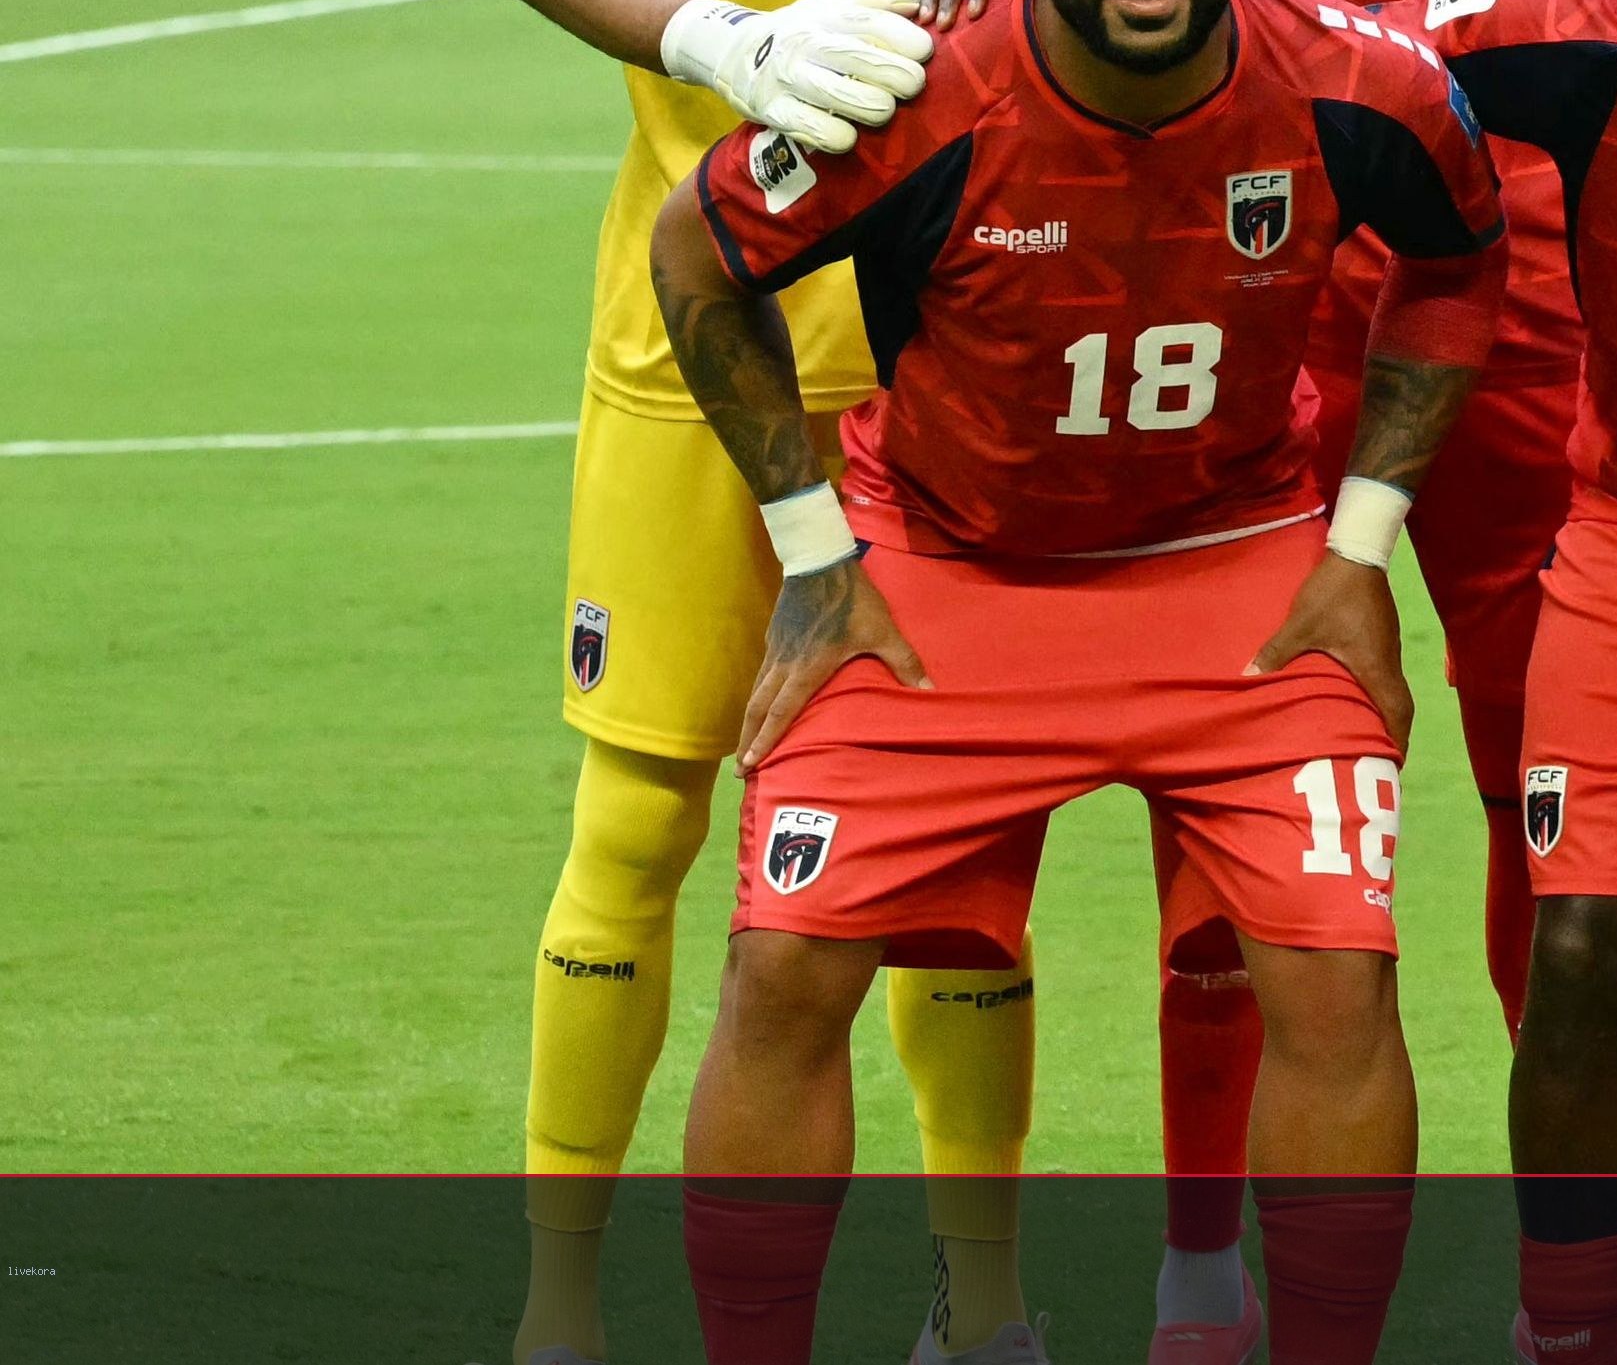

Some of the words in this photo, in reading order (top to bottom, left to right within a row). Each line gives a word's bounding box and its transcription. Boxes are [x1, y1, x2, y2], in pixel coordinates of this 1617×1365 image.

[1231, 175, 1287, 193] FCF
[973, 220, 1068, 252] capelli
[1016, 243, 1068, 255] SPORT
[1056, 321, 1223, 436] 18
[577, 603, 606, 622] FCF
[1527, 769, 1564, 786] FCF
[779, 811, 832, 827] FCF
[1292, 755, 1401, 881] 18
[542, 949, 635, 981] capelli
